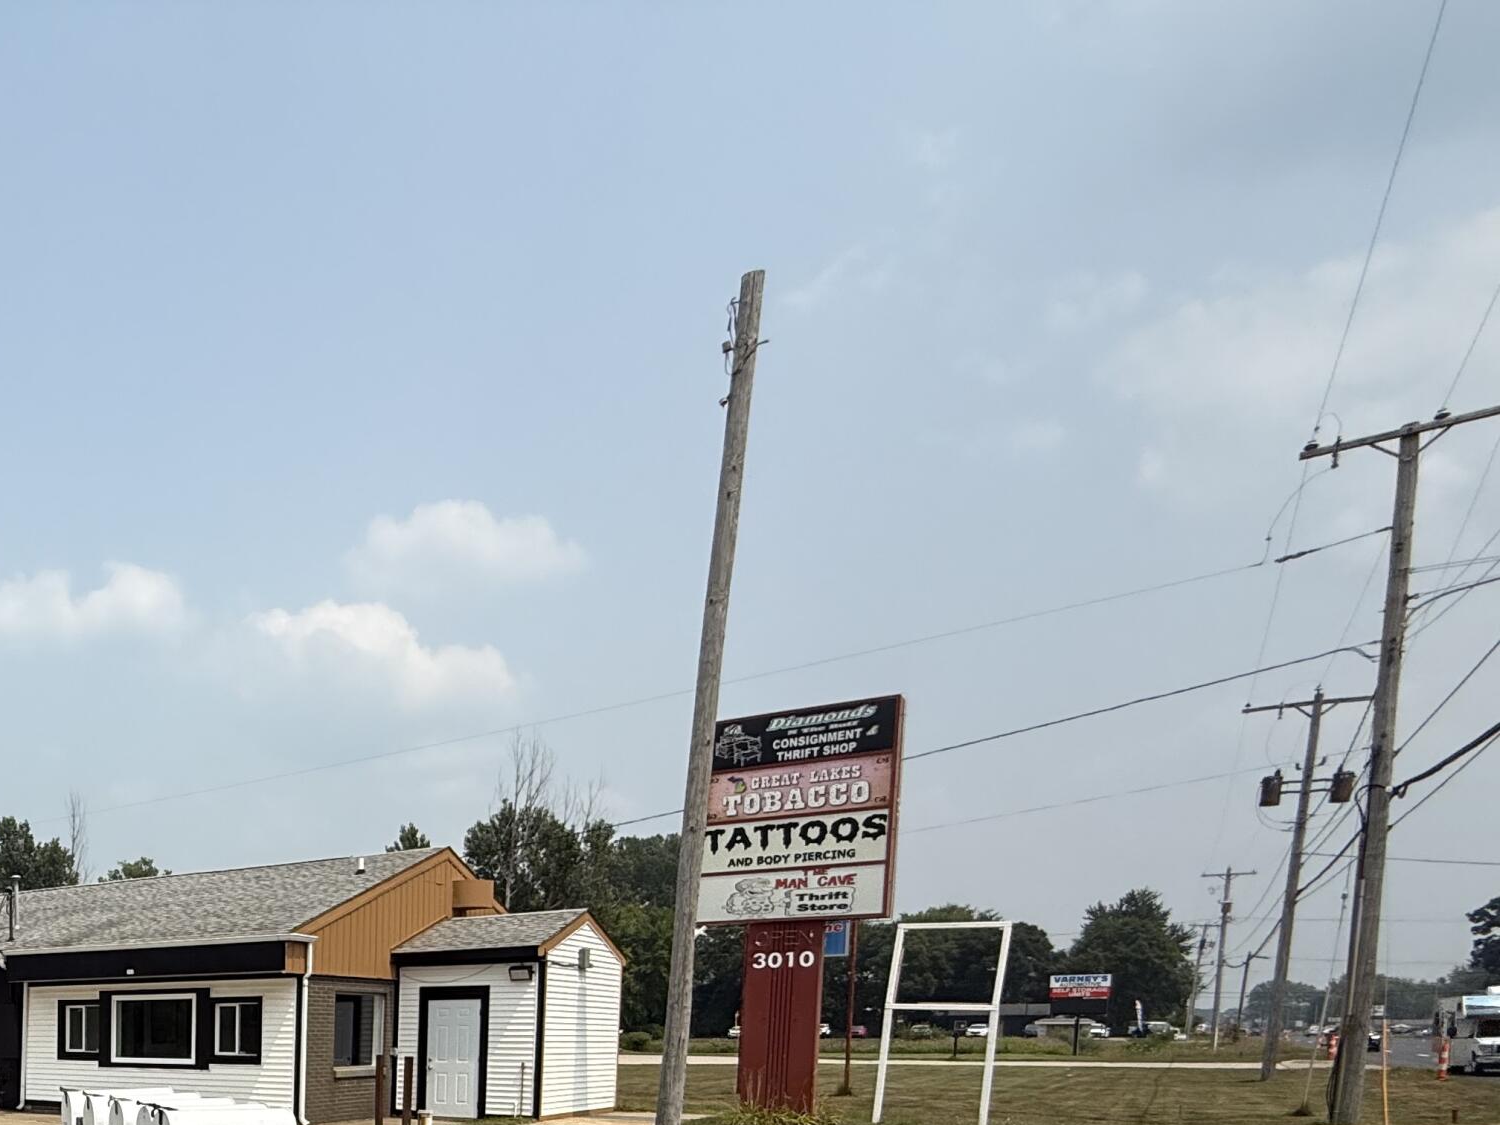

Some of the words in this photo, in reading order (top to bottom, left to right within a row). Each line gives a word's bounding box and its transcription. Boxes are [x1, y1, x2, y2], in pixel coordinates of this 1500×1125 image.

[765, 704, 878, 732] Diamonds
[772, 727, 864, 750] CONSIGNMENT
[776, 746, 820, 762] THRIFT
[822, 741, 858, 756] SHOP
[751, 772, 800, 790] GREAT
[809, 765, 862, 783] LAKES
[722, 781, 870, 817] TOBACCO
[704, 813, 888, 855] TATTOOS
[727, 857, 753, 868] AND
[756, 854, 791, 866] BODY
[794, 848, 856, 863] PIERCING
[774, 877, 808, 890] MAN
[817, 873, 858, 887] CAVE
[795, 891, 849, 902] Thrift
[796, 902, 849, 912] Store
[752, 950, 815, 969] 3010
[1053, 975, 1109, 983] VARNEY'S
